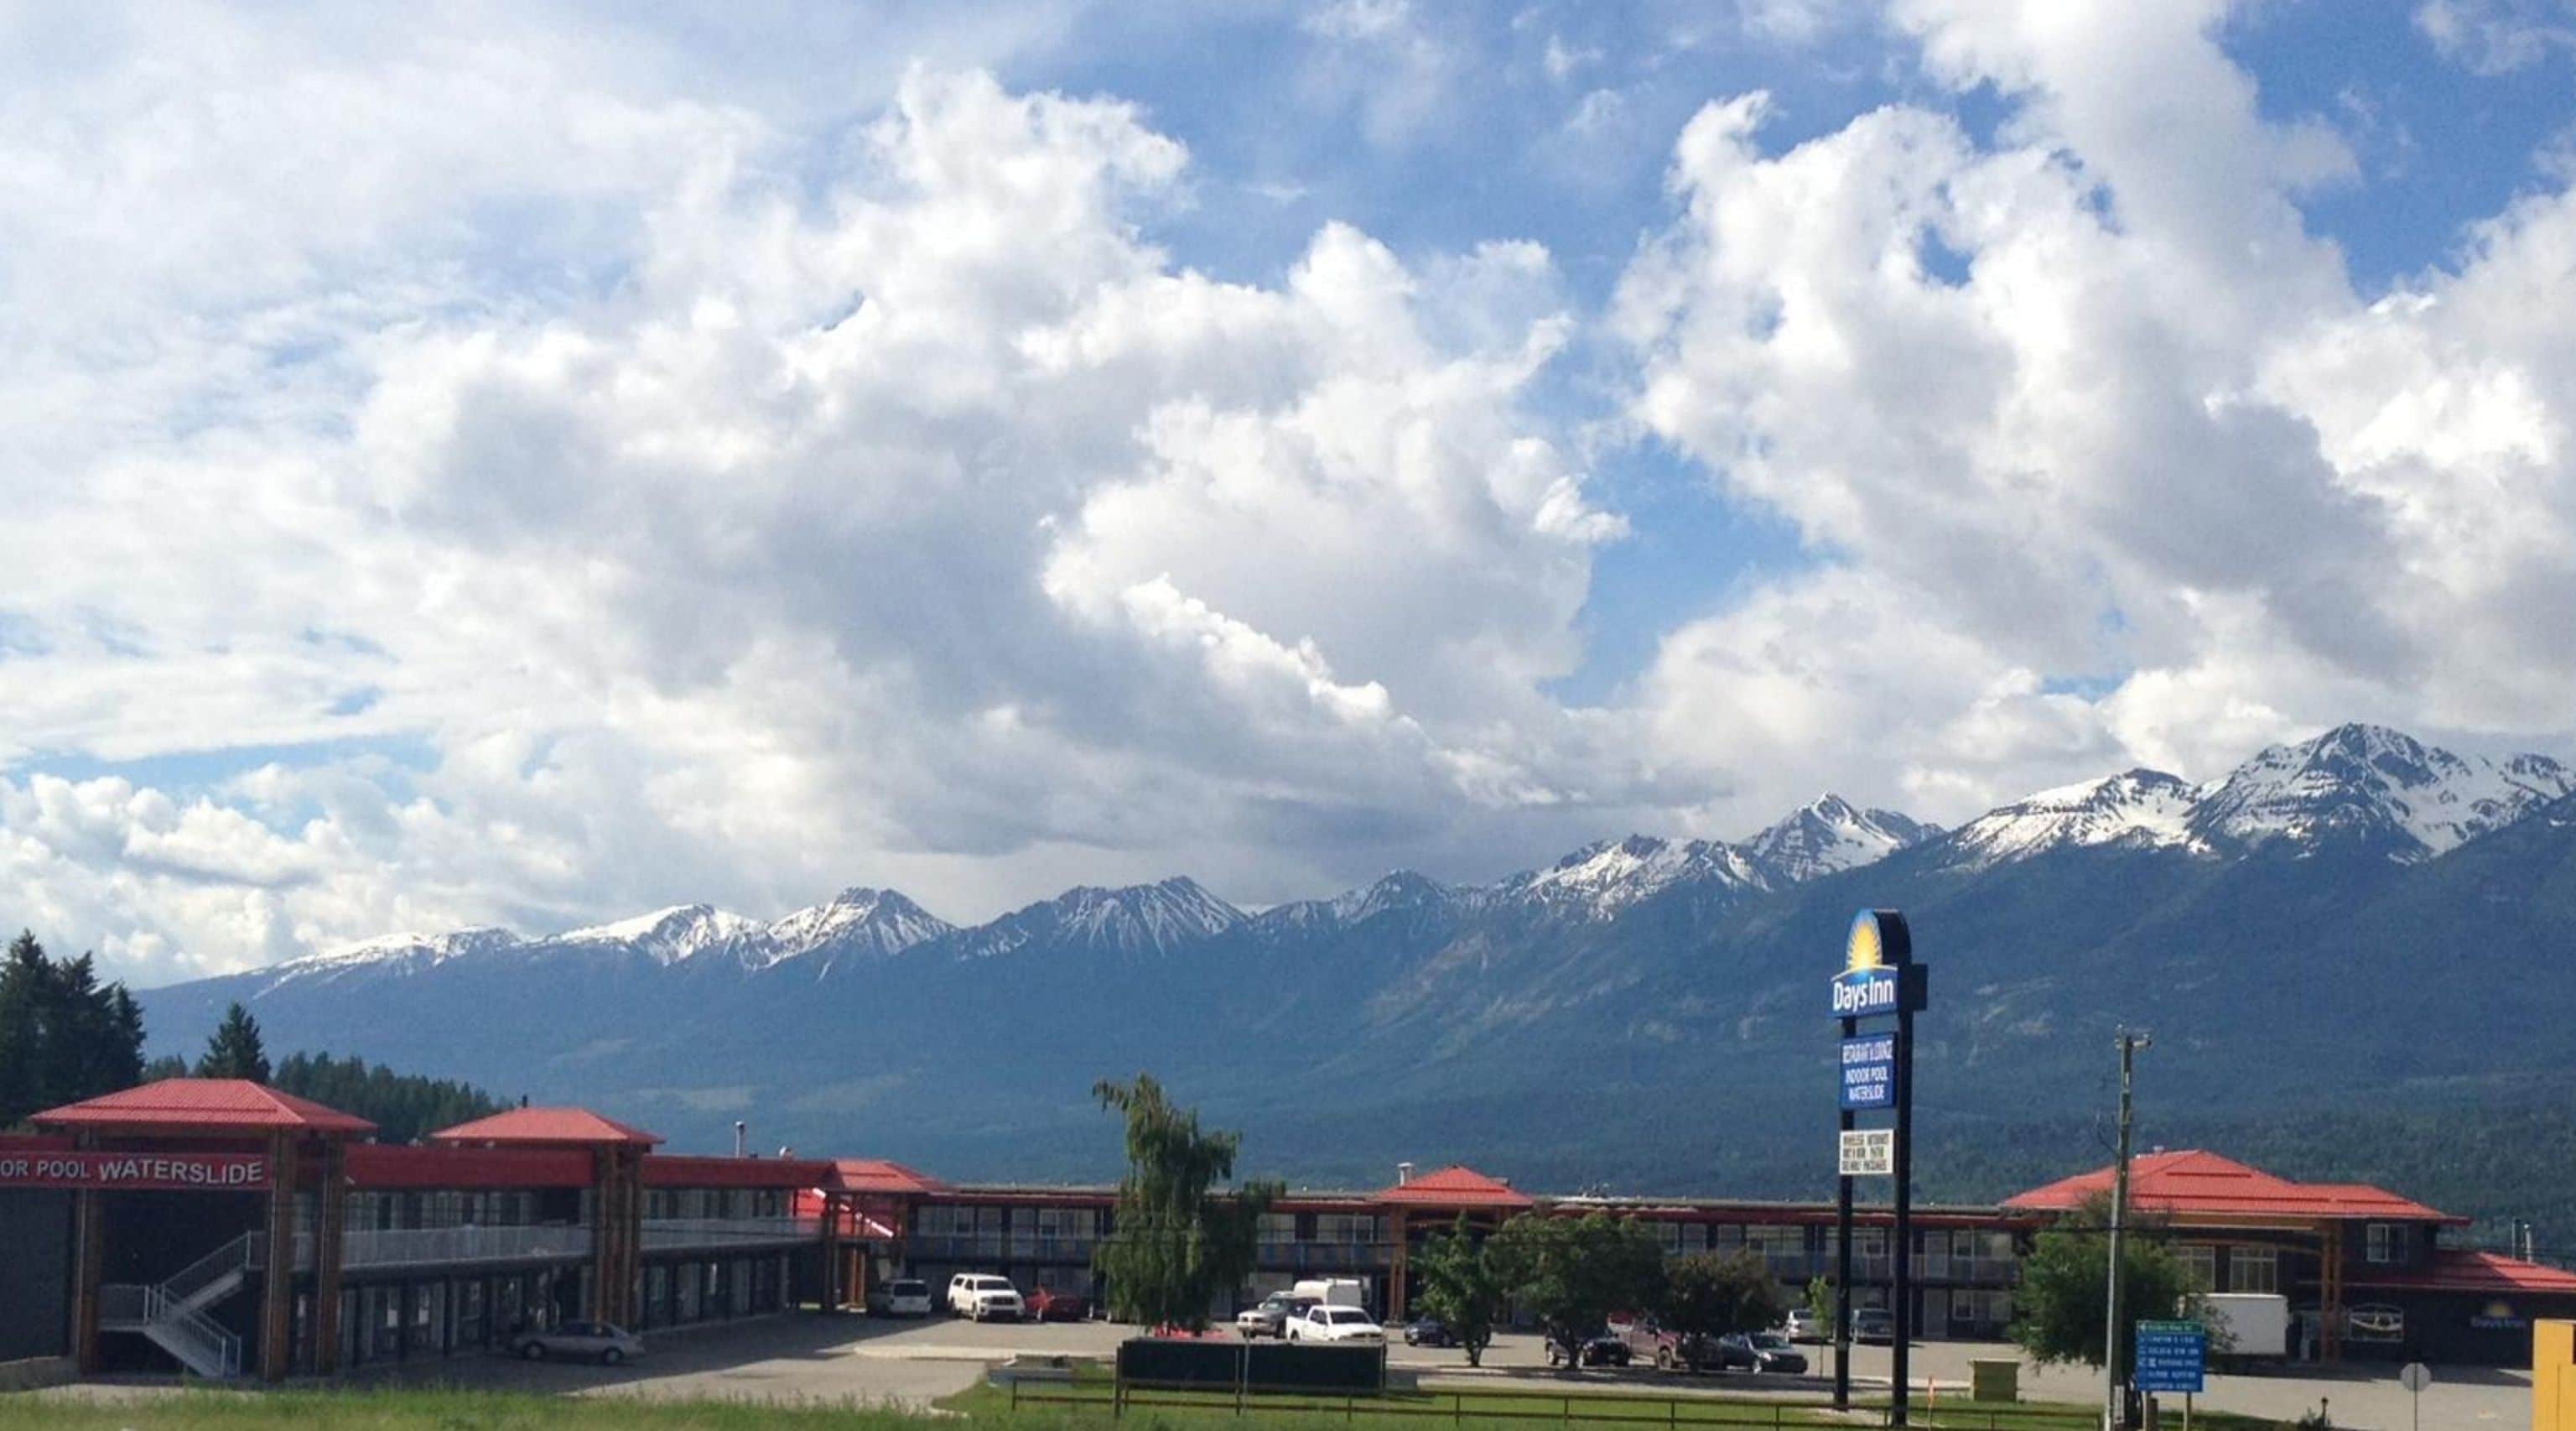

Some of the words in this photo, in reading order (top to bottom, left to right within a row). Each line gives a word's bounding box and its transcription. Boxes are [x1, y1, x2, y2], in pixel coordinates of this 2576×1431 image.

[1833, 981, 1867, 1012] Days
[1870, 976, 1893, 1005] Inn
[37, 1160, 90, 1180] POOL
[97, 1158, 263, 1184] WATERSLIDE
